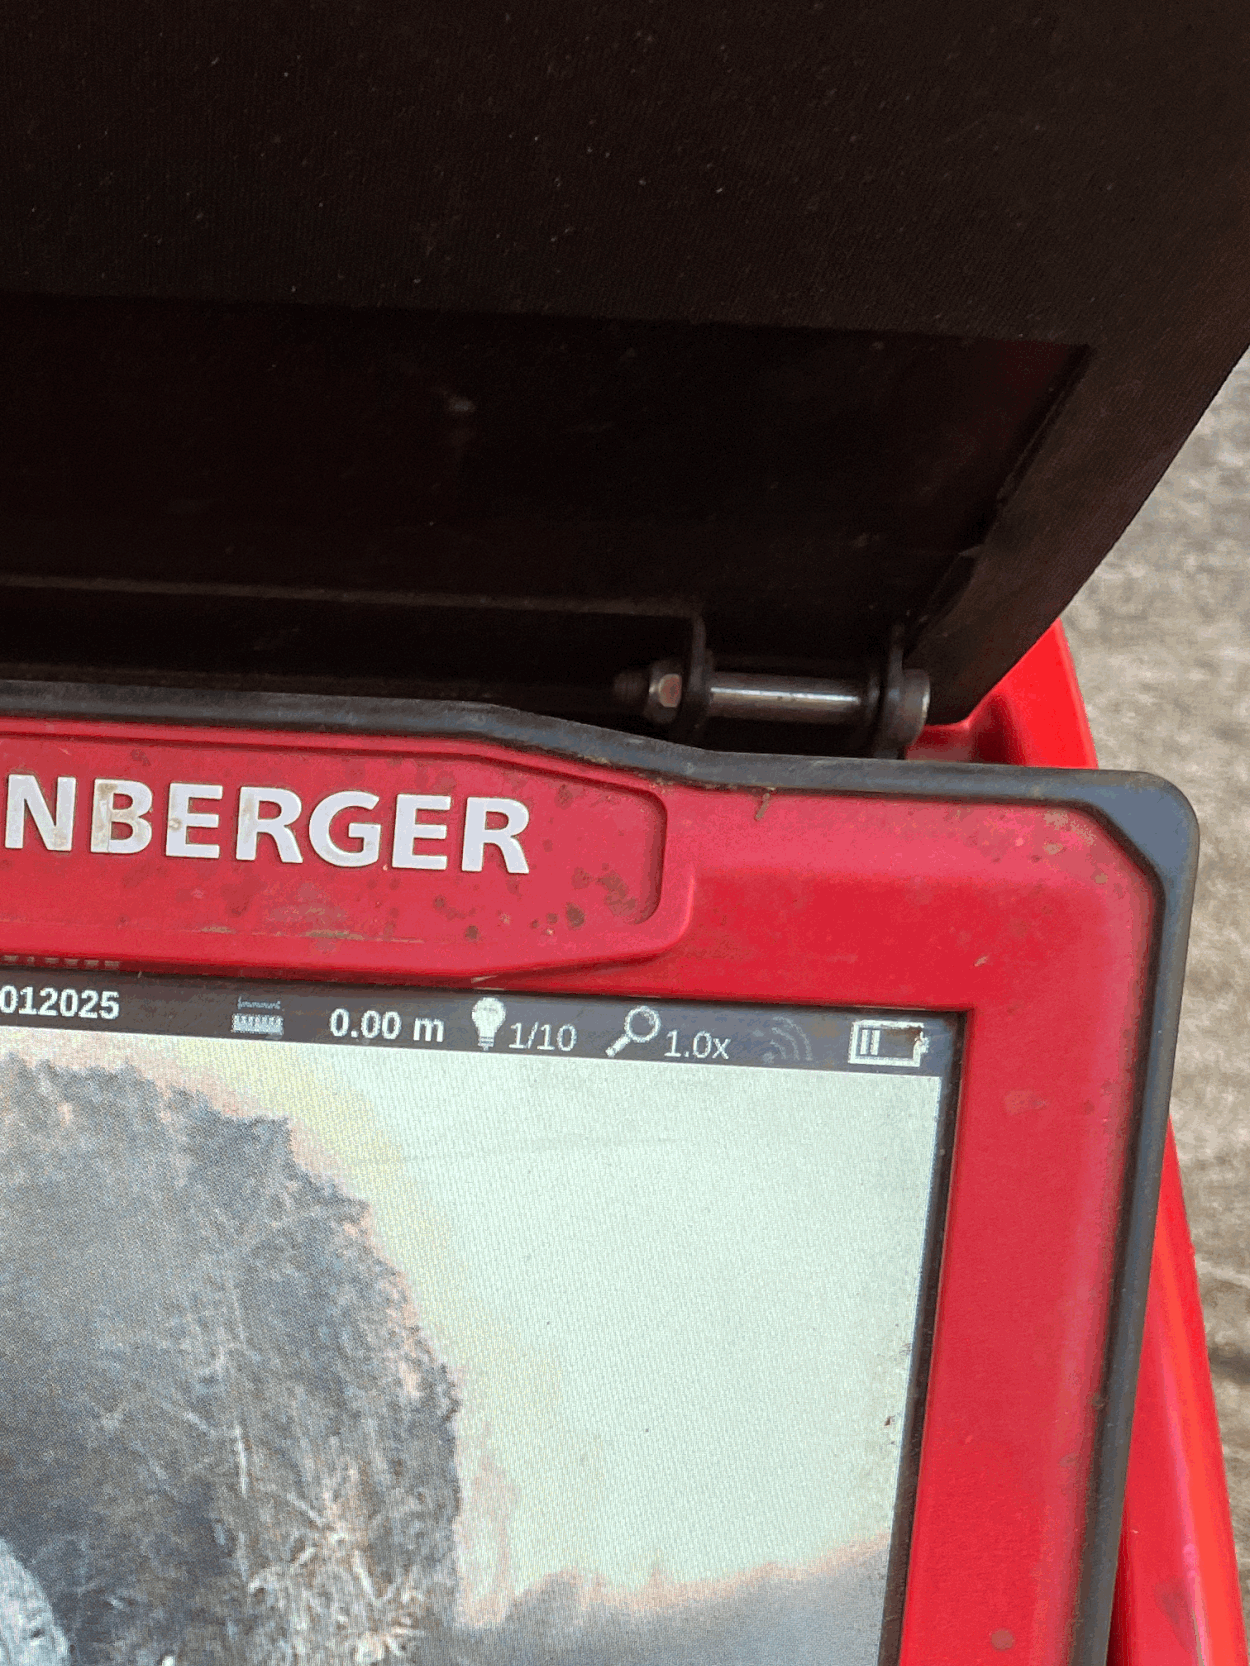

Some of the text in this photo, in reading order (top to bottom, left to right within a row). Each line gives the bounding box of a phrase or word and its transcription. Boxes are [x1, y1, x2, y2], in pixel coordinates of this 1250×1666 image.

[329, 1008, 445, 1043] 0.00 m
[508, 1021, 578, 1052] 1/10
[663, 1029, 732, 1060] 1.0x
